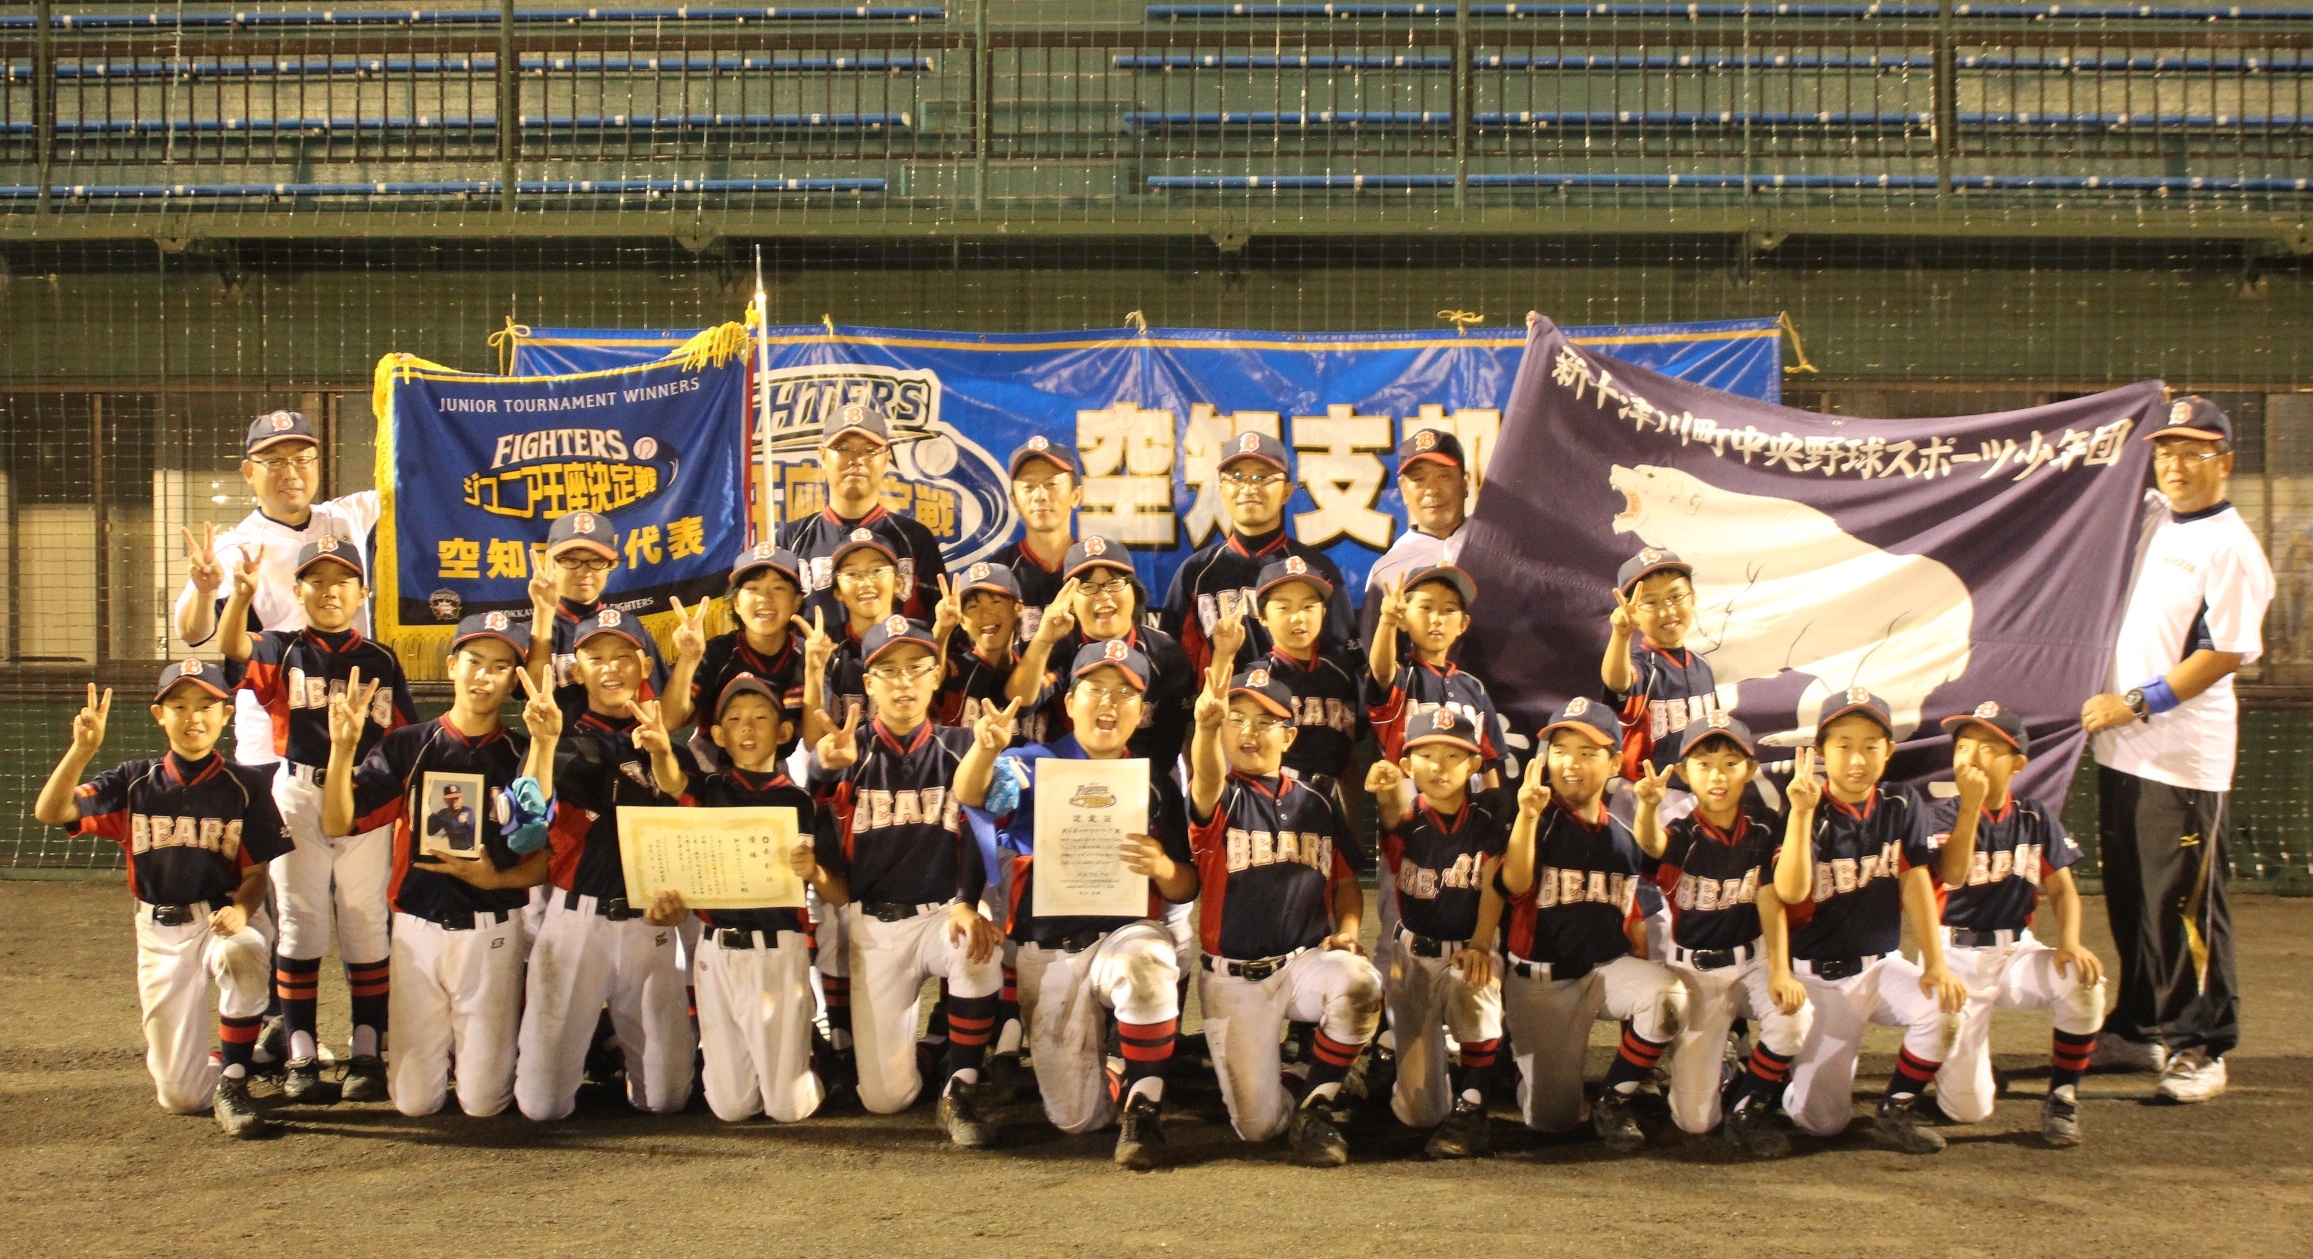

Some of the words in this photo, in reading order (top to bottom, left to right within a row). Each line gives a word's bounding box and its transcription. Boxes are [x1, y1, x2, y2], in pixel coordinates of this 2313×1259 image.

[439, 399, 497, 412] JUNIOR
[504, 392, 616, 412] TOURNAMENT
[623, 377, 700, 403] WINNERS
[270, 410, 294, 432] B
[843, 405, 864, 425] B
[1551, 345, 2134, 480] 新十津川町中央野球スポーツ少年団
[2167, 402, 2194, 425] B
[490, 428, 629, 469] FIGHTERS
[1239, 430, 1260, 453] B
[1414, 431, 1435, 451] B
[572, 512, 596, 534] B
[317, 534, 339, 553] B
[437, 515, 706, 579] 空知代表
[753, 541, 776, 560] B
[1084, 535, 1107, 557] B
[1284, 555, 1307, 574] B
[1638, 546, 1662, 566] B
[967, 561, 991, 582] B
[484, 611, 508, 631] B
[598, 609, 622, 627] B
[885, 614, 909, 637] B
[1104, 639, 1129, 661] B
[179, 658, 203, 676] B
[1245, 668, 1270, 688] B
[1563, 696, 1589, 718] B
[1972, 701, 1999, 719] B
[1432, 707, 1455, 730] B
[1707, 708, 1731, 729] B
[131, 813, 244, 861] BEARS
[1226, 827, 1333, 881] BEARS
